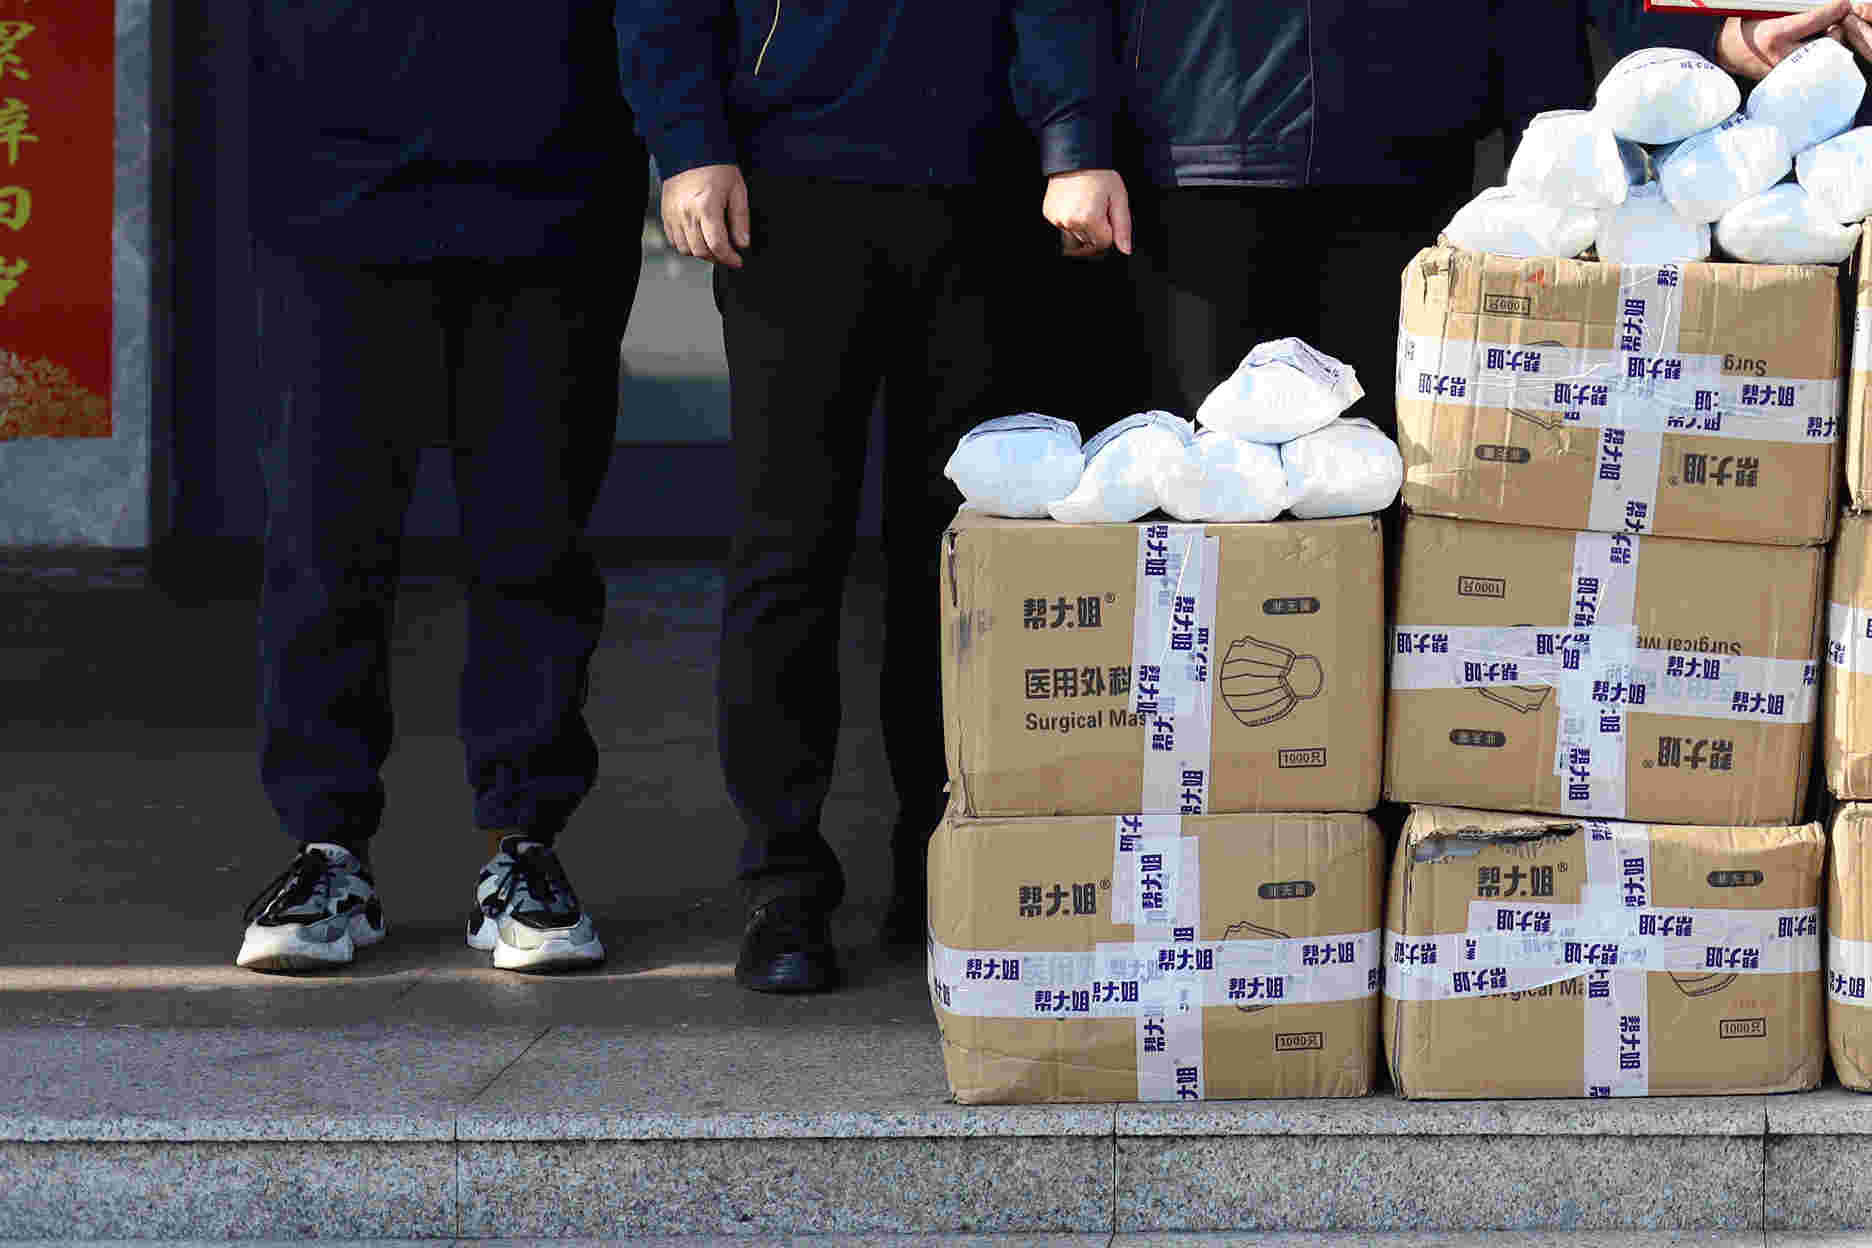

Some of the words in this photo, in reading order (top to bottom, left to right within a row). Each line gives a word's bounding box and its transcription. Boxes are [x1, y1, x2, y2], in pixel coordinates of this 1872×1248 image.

[1487, 349, 1541, 372] 帮大姐
[1628, 357, 1681, 380] 帮大姐
[1554, 383, 1608, 405] 帮大姐
[1742, 384, 1794, 405] 帮大姐
[1398, 632, 1448, 653] 帮大姐
[1464, 661, 1519, 682] 帮大姐
[1666, 656, 1720, 680] 帮大姐
[1025, 665, 1131, 699] 医用外科
[1592, 680, 1645, 705] 帮大姐
[1732, 692, 1784, 715] 帮大姐
[1025, 711, 1102, 733] Surgical
[1497, 910, 1551, 932] 帮大姐
[1640, 914, 1693, 936] 帮大姐
[1159, 949, 1213, 971] 帮大姐
[1303, 942, 1354, 965] 帮大姐
[1564, 942, 1619, 965] 帮大姐
[1706, 946, 1759, 968] 帮大姐
[967, 959, 1019, 981] 帮大姐
[1453, 968, 1507, 992] 帮大姐
[1228, 976, 1283, 998] 帮大姐
[1035, 990, 1090, 1012] 帮大姐
[1619, 1016, 1641, 1069] 帮大姐
